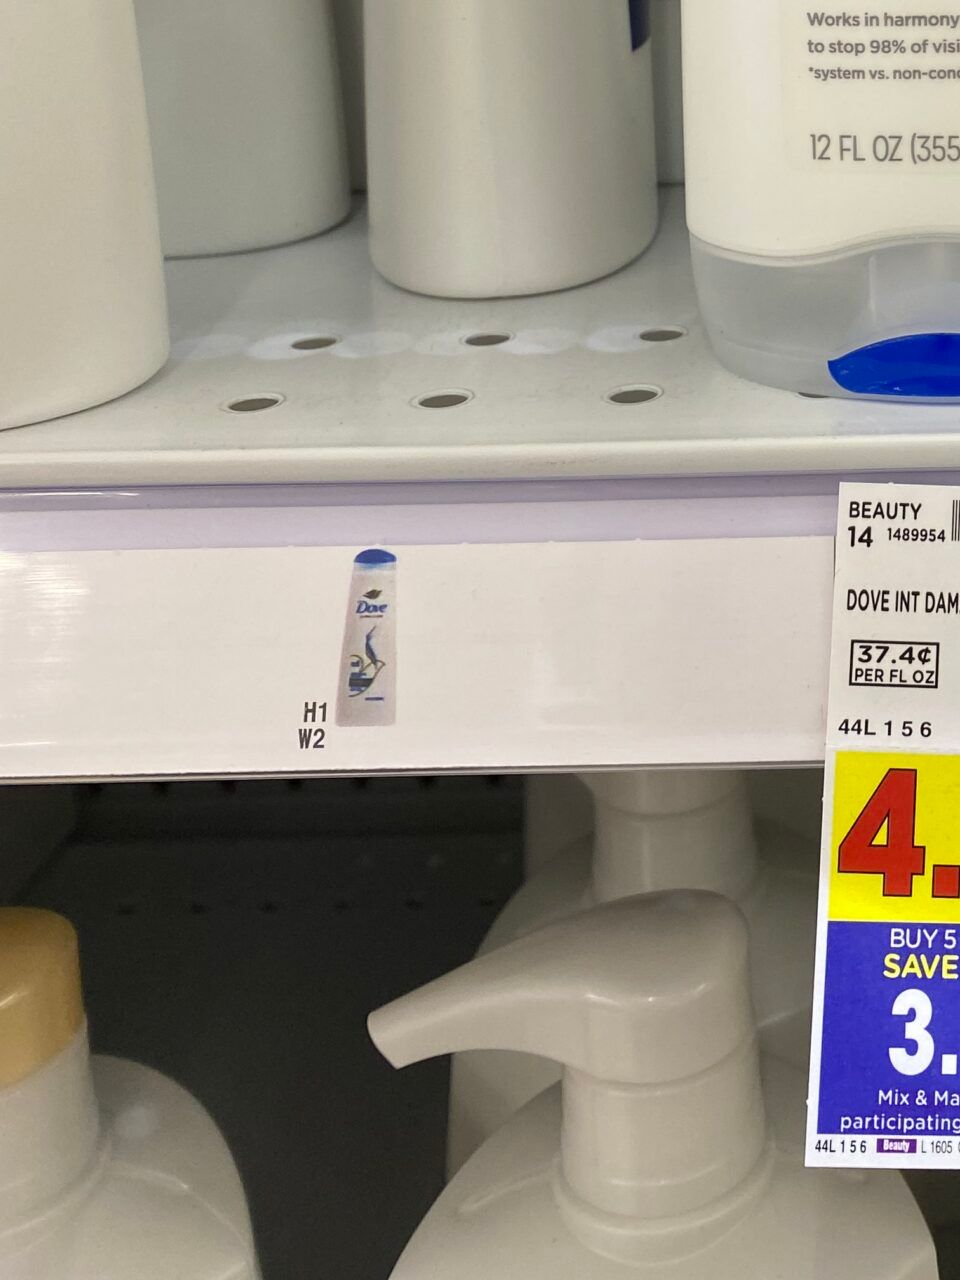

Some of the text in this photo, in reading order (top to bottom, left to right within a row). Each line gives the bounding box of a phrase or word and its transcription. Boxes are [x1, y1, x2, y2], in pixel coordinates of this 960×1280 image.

[807, 12, 860, 27] Works
[864, 12, 879, 27] in
[884, 12, 960, 28] harmony
[807, 40, 825, 54] to
[828, 39, 866, 57] stop
[870, 39, 906, 54] 98%
[910, 38, 928, 53] of
[869, 68, 890, 81] vs.
[810, 134, 831, 160] 12
[839, 135, 866, 162] FL
[872, 135, 903, 162] OZ
[849, 502, 922, 519] BEAUTY
[847, 526, 946, 548] 14 1489954
[356, 600, 387, 614] Dove
[846, 589, 890, 611] DOVE
[895, 591, 920, 613] INT
[858, 645, 932, 665] 37.4¢
[855, 669, 935, 684] PER FL OZ
[304, 702, 327, 722] H1
[299, 728, 325, 749] W2
[890, 928, 936, 949] BUY
[943, 930, 956, 950] 5
[884, 954, 959, 980] SAVE
[878, 1090, 910, 1106] Mix
[915, 1090, 928, 1106] &
[883, 1139, 910, 1152] Beauty
[921, 1141, 927, 1153] L
[931, 1141, 953, 1154] 1605
